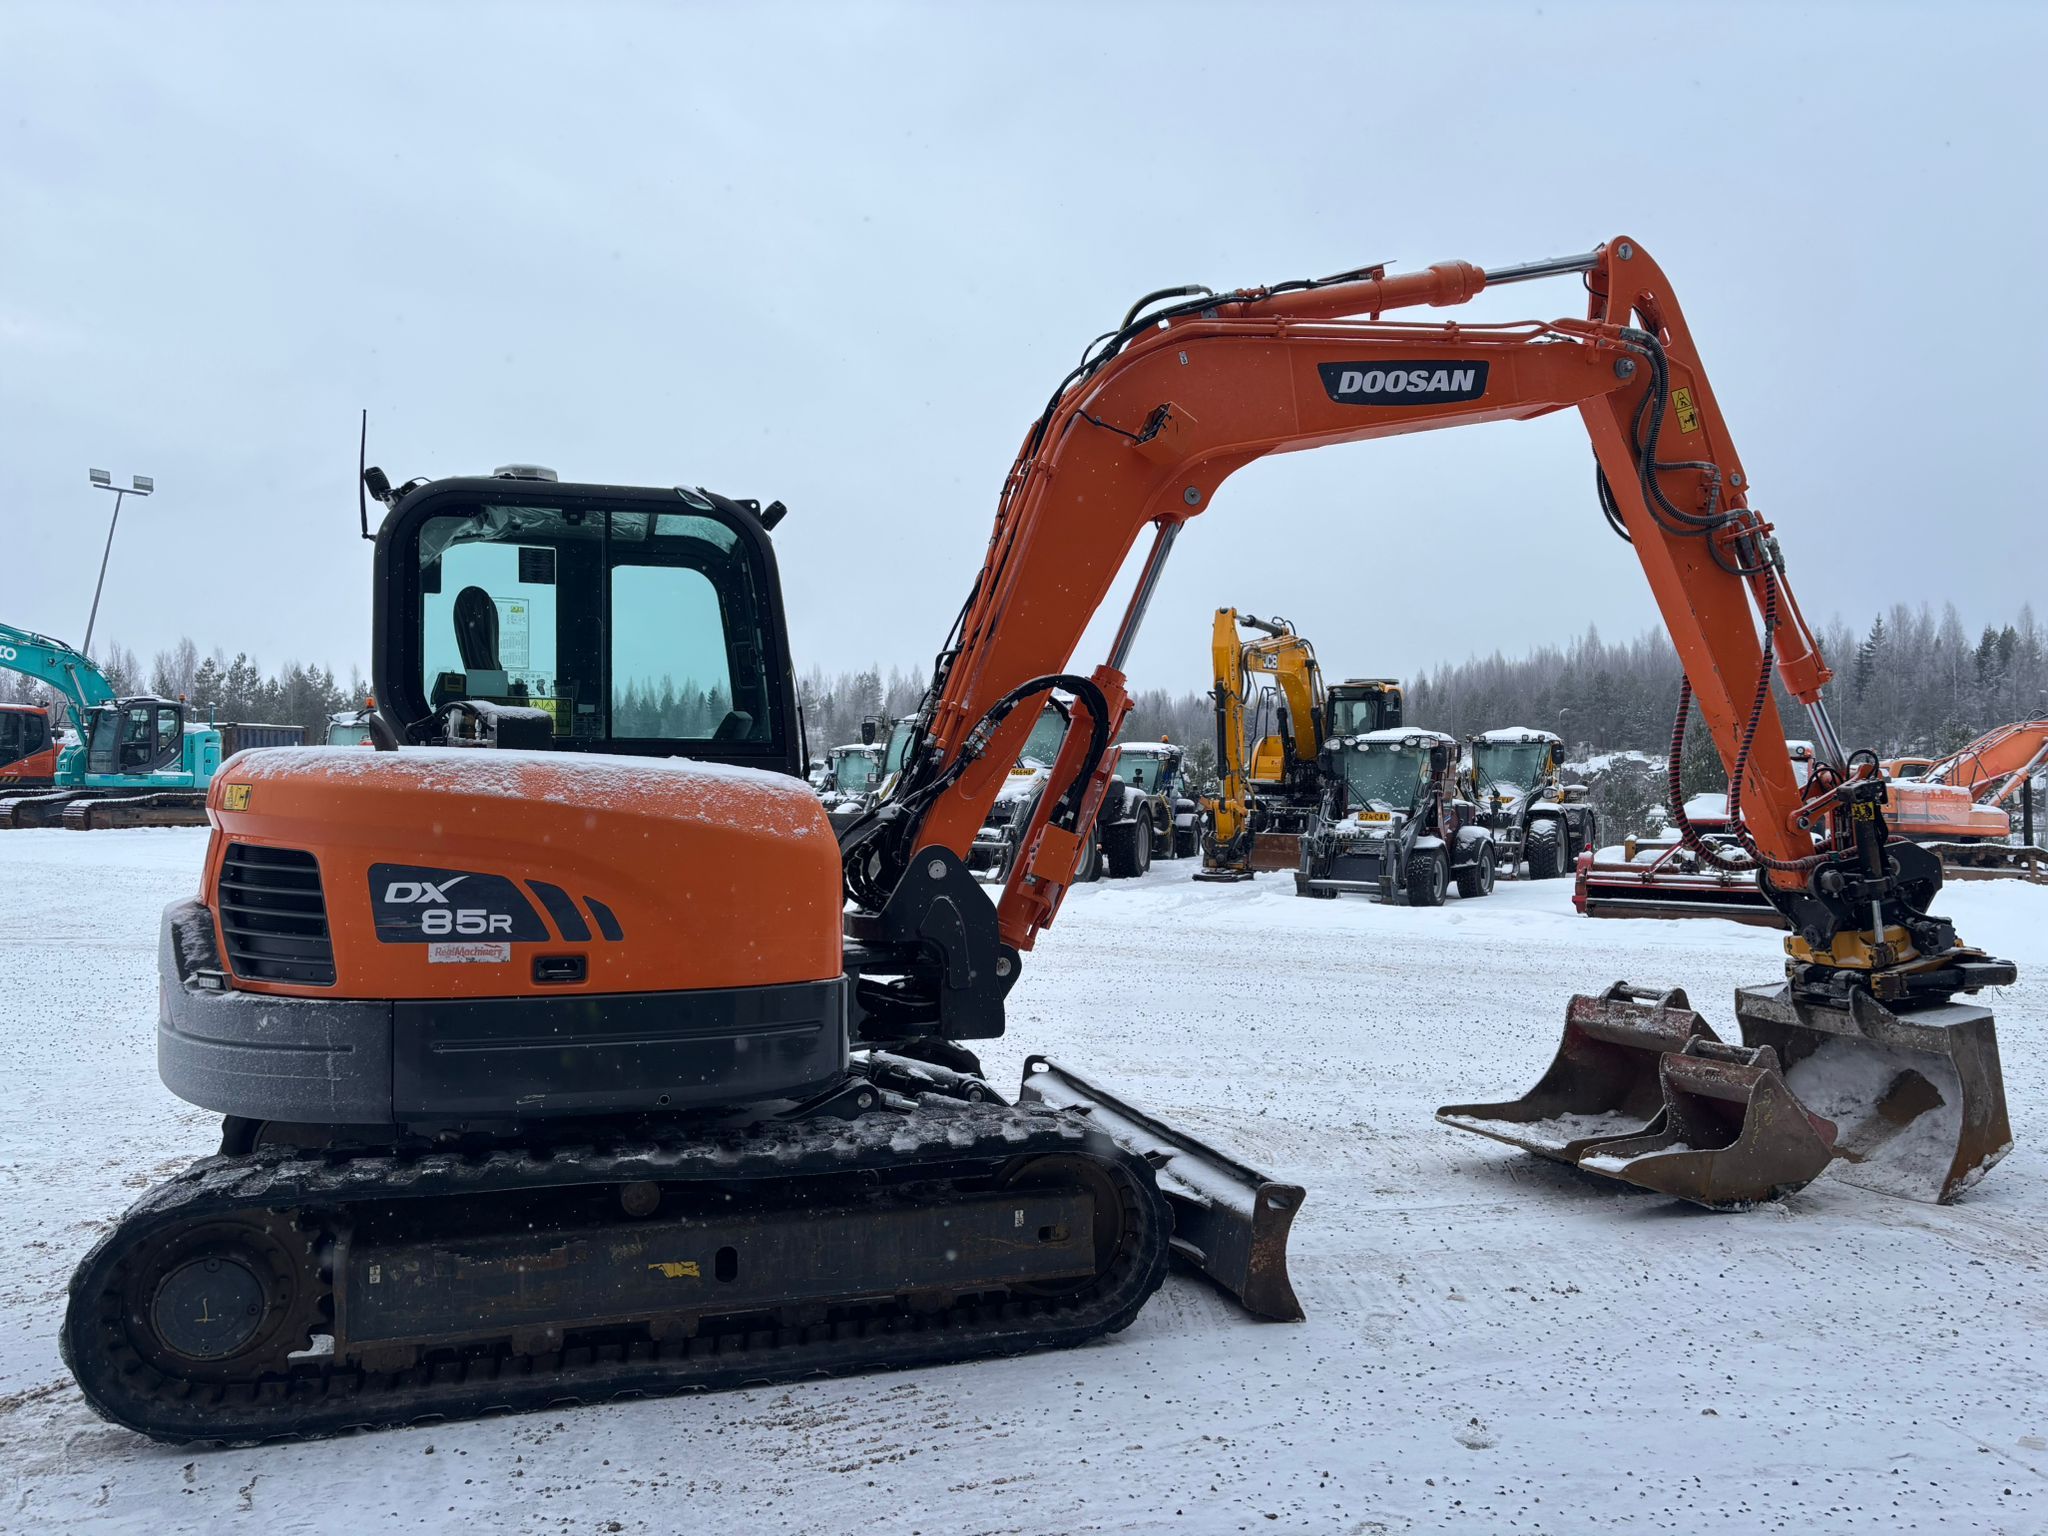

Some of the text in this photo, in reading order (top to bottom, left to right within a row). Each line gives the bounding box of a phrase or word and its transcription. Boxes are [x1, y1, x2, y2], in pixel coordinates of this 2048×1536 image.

[1338, 369, 1475, 393] DOOSAN
[1264, 655, 1278, 669] JCB
[385, 875, 470, 903] DX
[421, 909, 513, 934] 85R
